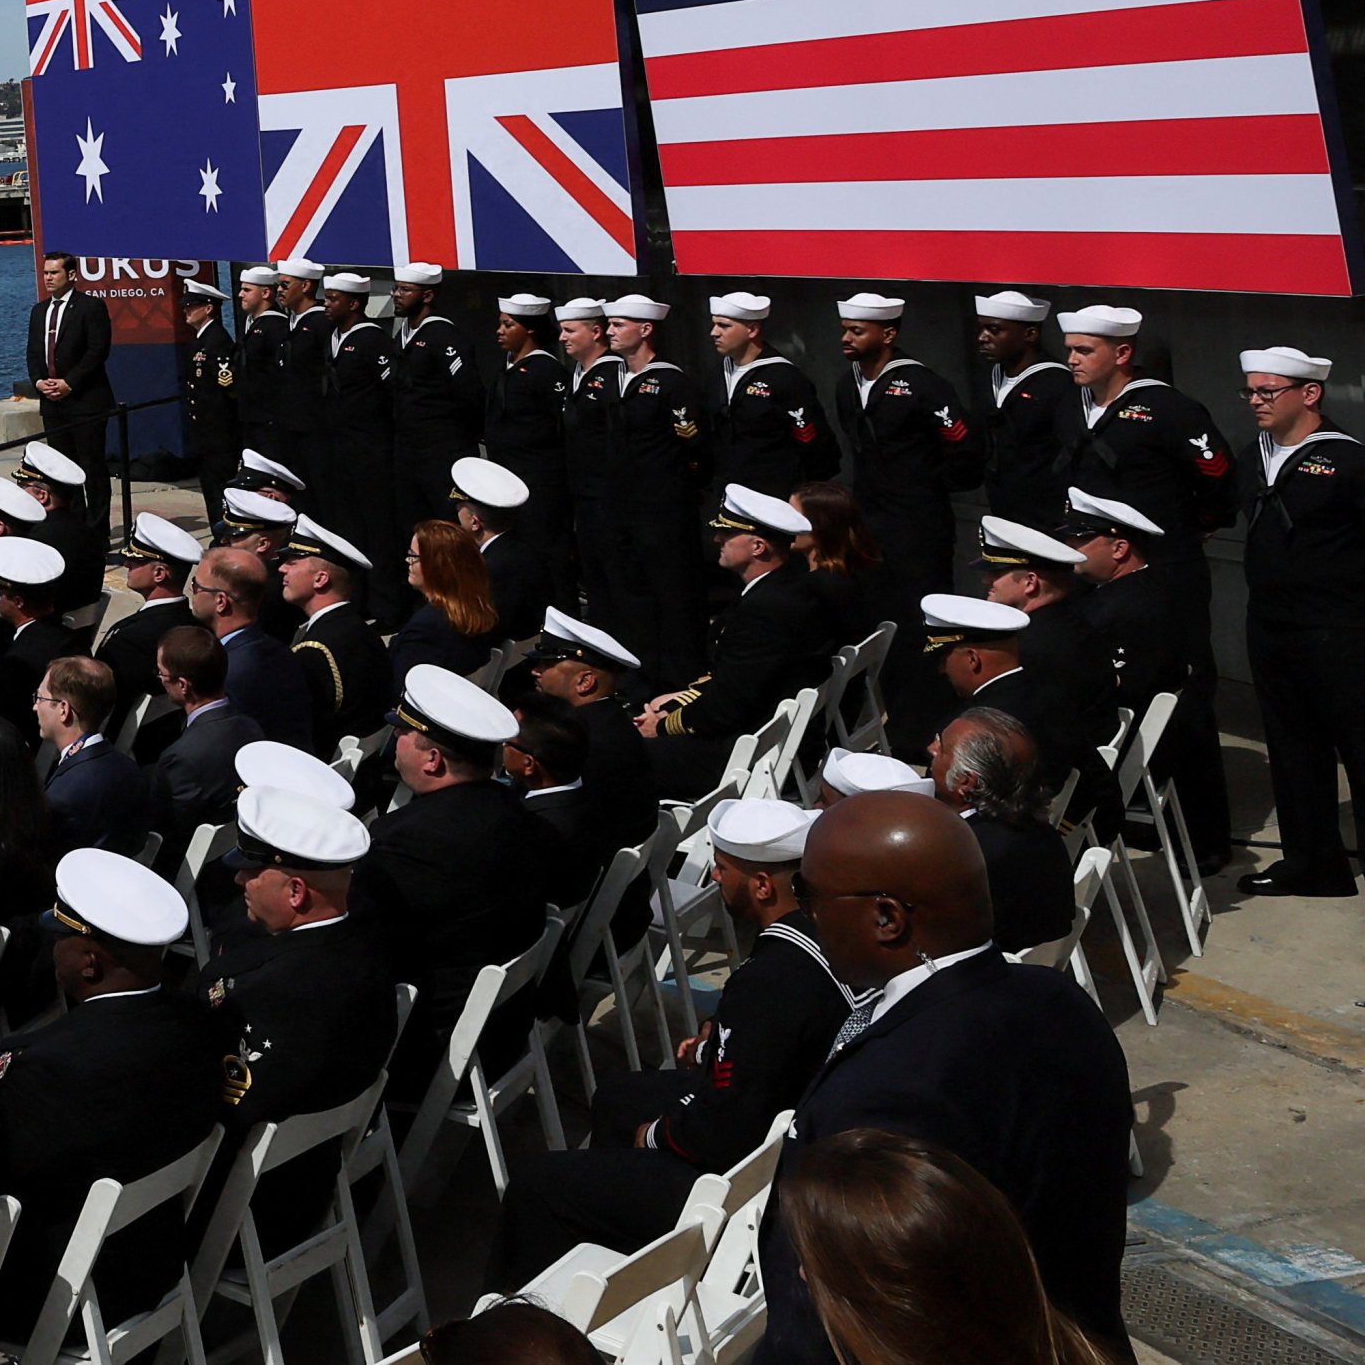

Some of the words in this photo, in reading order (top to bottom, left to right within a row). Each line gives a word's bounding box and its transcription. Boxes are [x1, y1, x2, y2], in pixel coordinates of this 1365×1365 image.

[77, 256, 200, 281] UKUS
[85, 290, 107, 298] SAN
[110, 288, 147, 298] DIEGO,
[151, 287, 165, 296] CA
